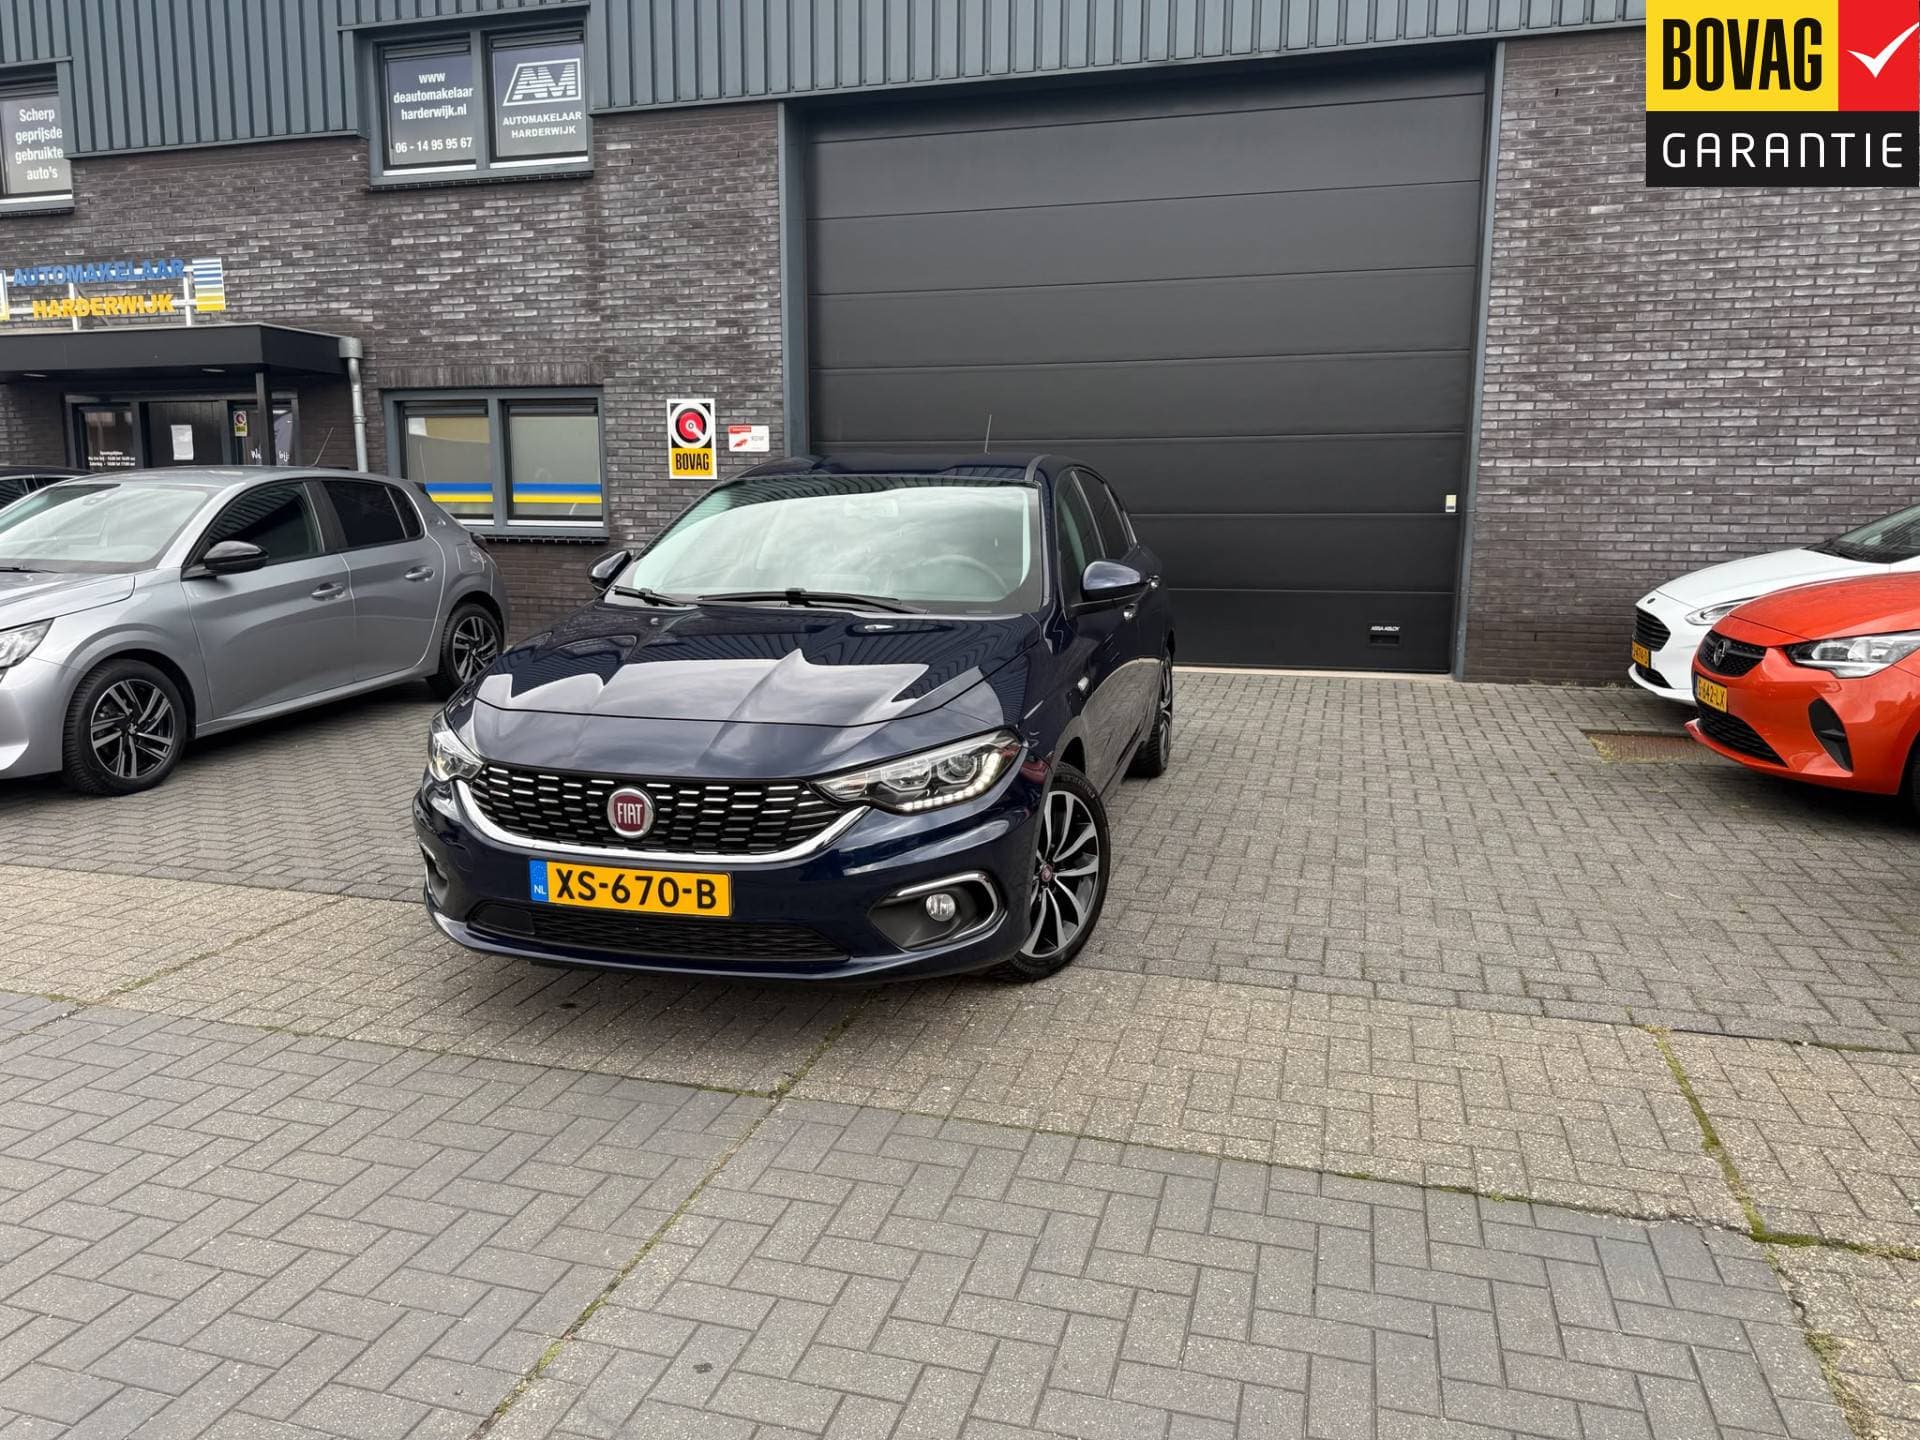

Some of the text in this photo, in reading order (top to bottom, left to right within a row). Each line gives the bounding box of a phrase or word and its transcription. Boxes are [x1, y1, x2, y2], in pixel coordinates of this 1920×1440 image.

[418, 72, 446, 84] www
[393, 87, 473, 104] deautomakelaar
[19, 108, 55, 122] Scherp
[401, 103, 467, 121] harderwijk.nl
[502, 111, 582, 126] AUTOMAKELAAR
[15, 126, 63, 145] geprijsde
[511, 125, 577, 139] HARDERWIJK
[395, 142, 408, 154] 06
[417, 140, 428, 152] 14
[431, 139, 443, 151] 95
[446, 138, 457, 150] 95
[460, 136, 473, 149] 67
[15, 146, 64, 164] gebruikte
[26, 166, 58, 180] auto's
[13, 258, 185, 287] AUTOMAKELAAR
[32, 292, 175, 320] HARDERWIJK
[675, 453, 710, 471] BOVAG
[617, 802, 643, 825] FIAT
[534, 868, 717, 909] NL XS-670-B
